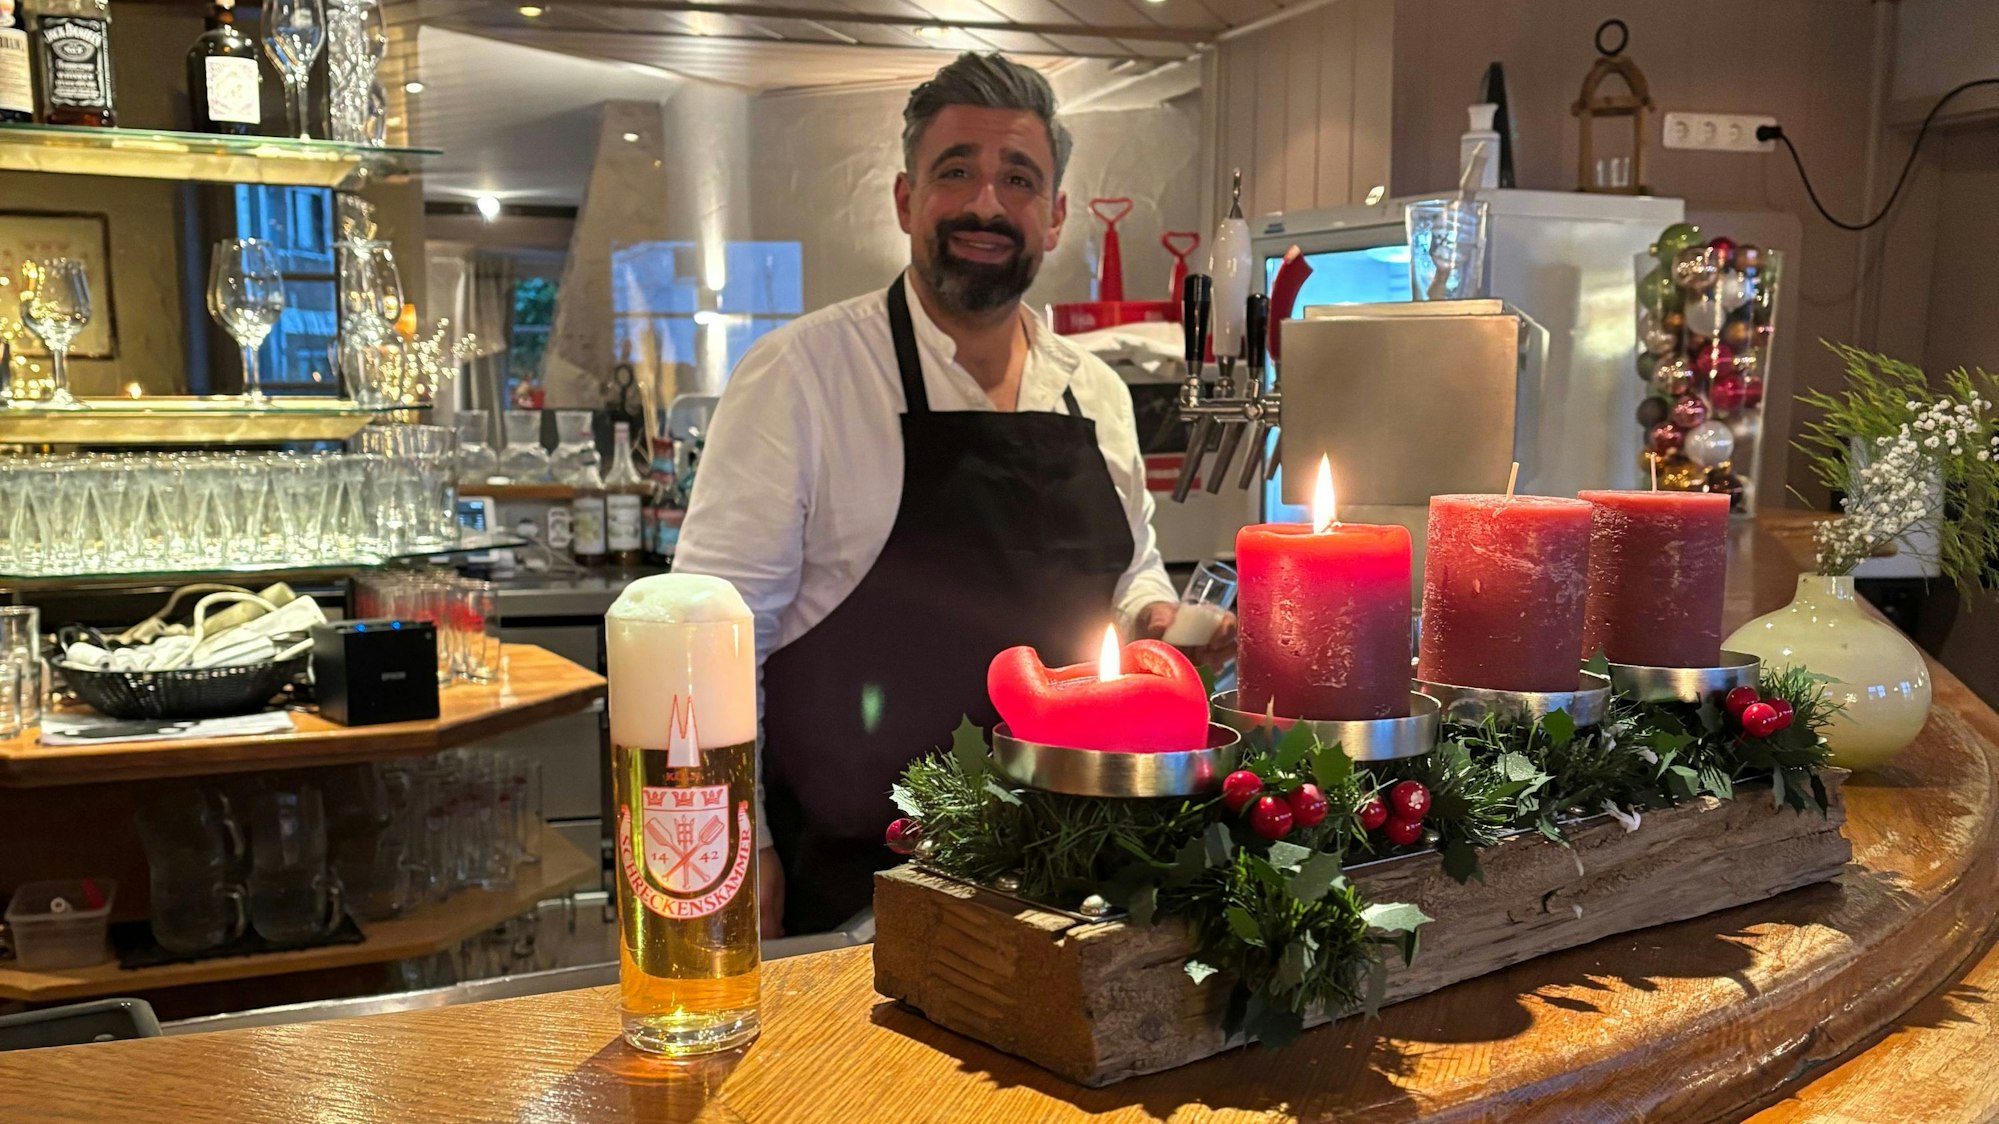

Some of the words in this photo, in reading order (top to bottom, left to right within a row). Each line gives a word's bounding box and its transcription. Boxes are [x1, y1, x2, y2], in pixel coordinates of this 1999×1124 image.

[621, 829, 751, 917] SCHRECKENSKAMMER
[651, 852, 669, 865] 14
[699, 850, 719, 864] 42
